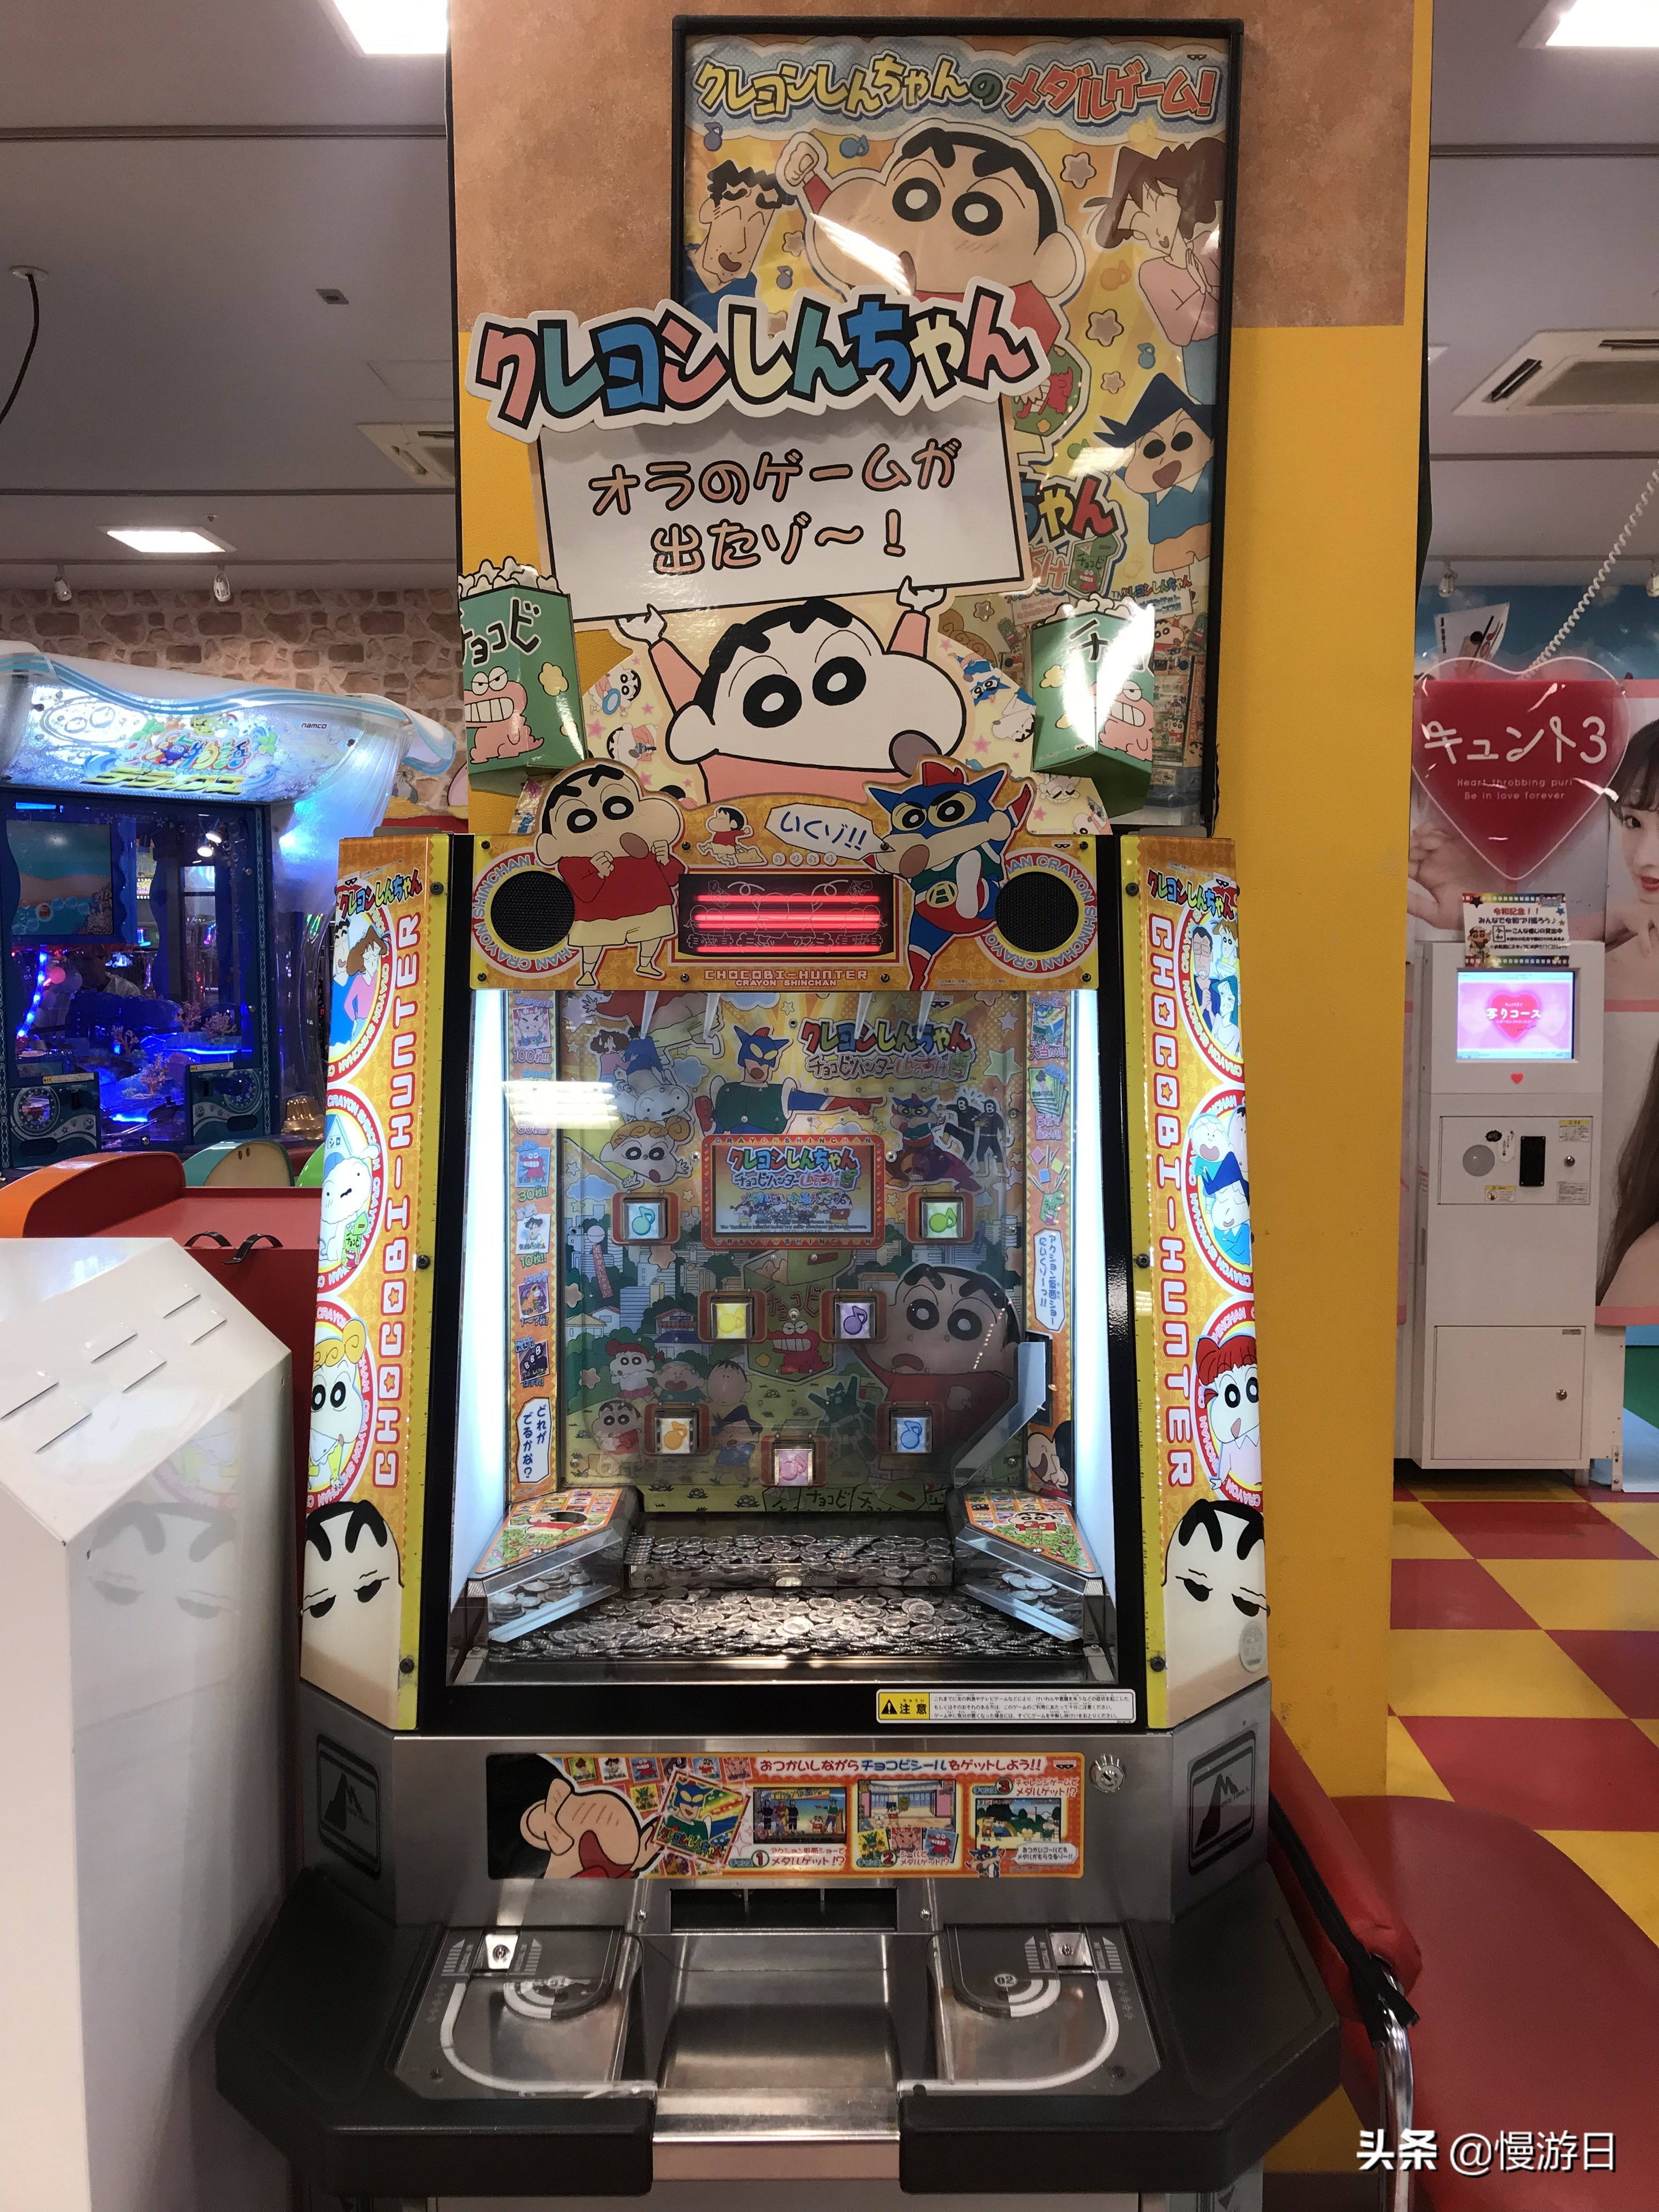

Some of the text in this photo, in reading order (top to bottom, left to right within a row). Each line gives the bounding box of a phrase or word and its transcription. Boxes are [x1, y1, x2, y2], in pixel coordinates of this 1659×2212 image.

[588, 438, 962, 515] オラのゲームが
[1525, 791, 1565, 799] forever
[472, 855, 531, 919] SHINCHAN
[1036, 855, 1094, 903] CRAYON
[475, 922, 531, 970] CRAYON
[985, 932, 1037, 970] CRAYO
[1042, 906, 1097, 970] SHINCHAN
[373, 963, 389, 1024] CRAYON
[537, 1403, 547, 1444] どれが
[998, 1779, 1010, 1792] 3
[756, 1852, 763, 1865] 1
[883, 1852, 894, 1865] 2
